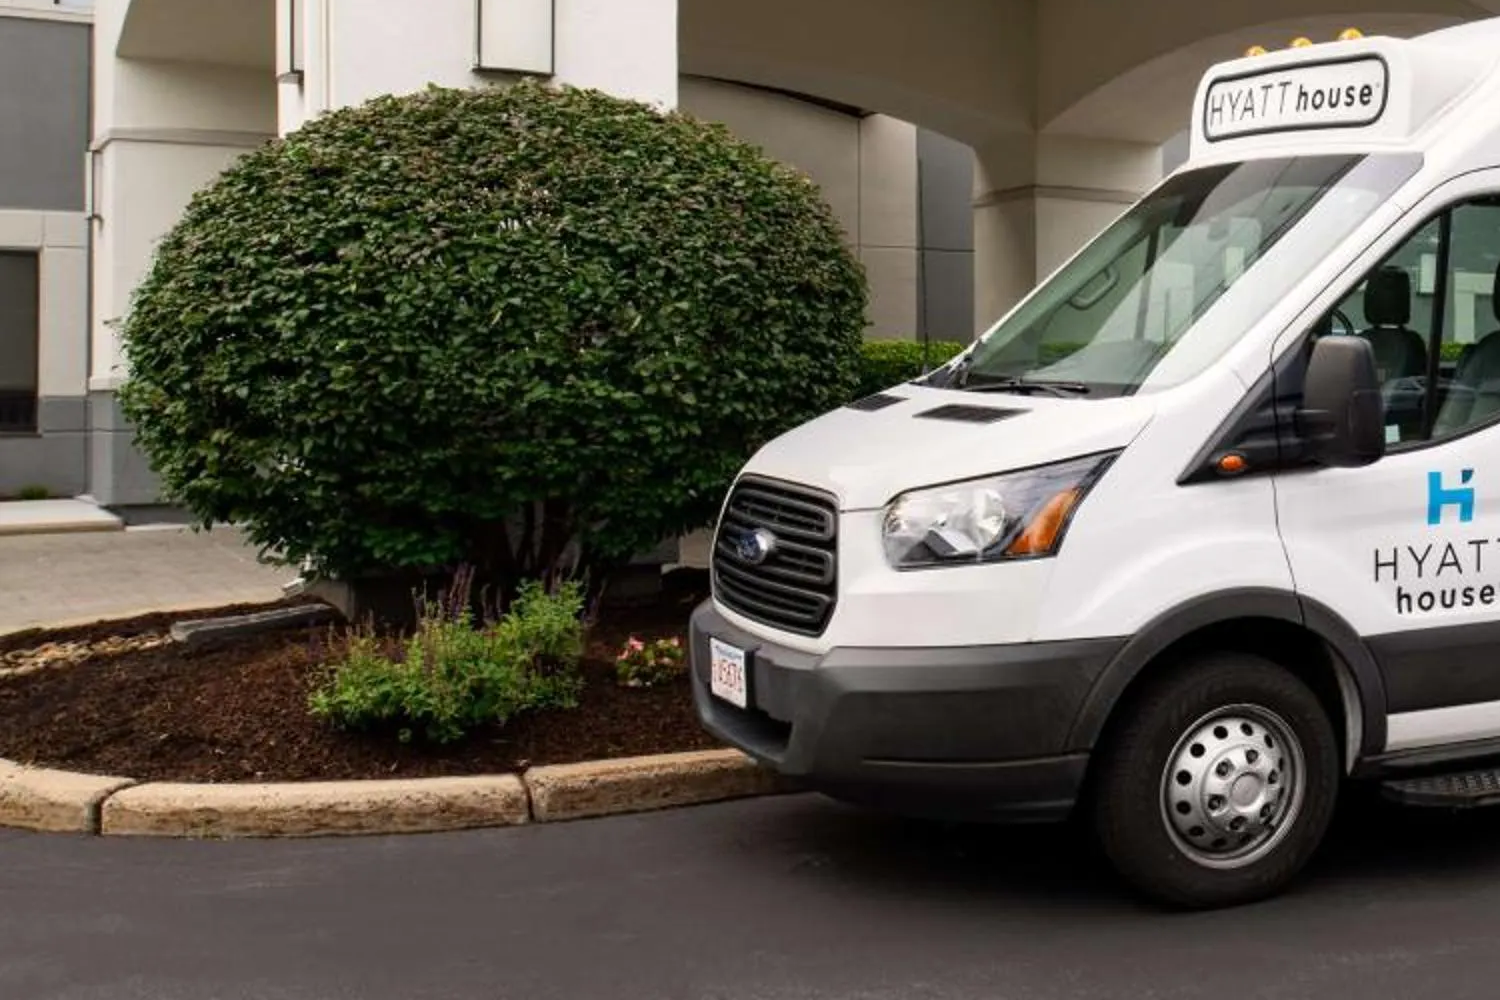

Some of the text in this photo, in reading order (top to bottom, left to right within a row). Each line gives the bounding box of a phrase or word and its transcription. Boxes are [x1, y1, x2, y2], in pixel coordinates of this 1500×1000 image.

[1209, 81, 1373, 128] HYATT house
[1397, 584, 1495, 614] house
